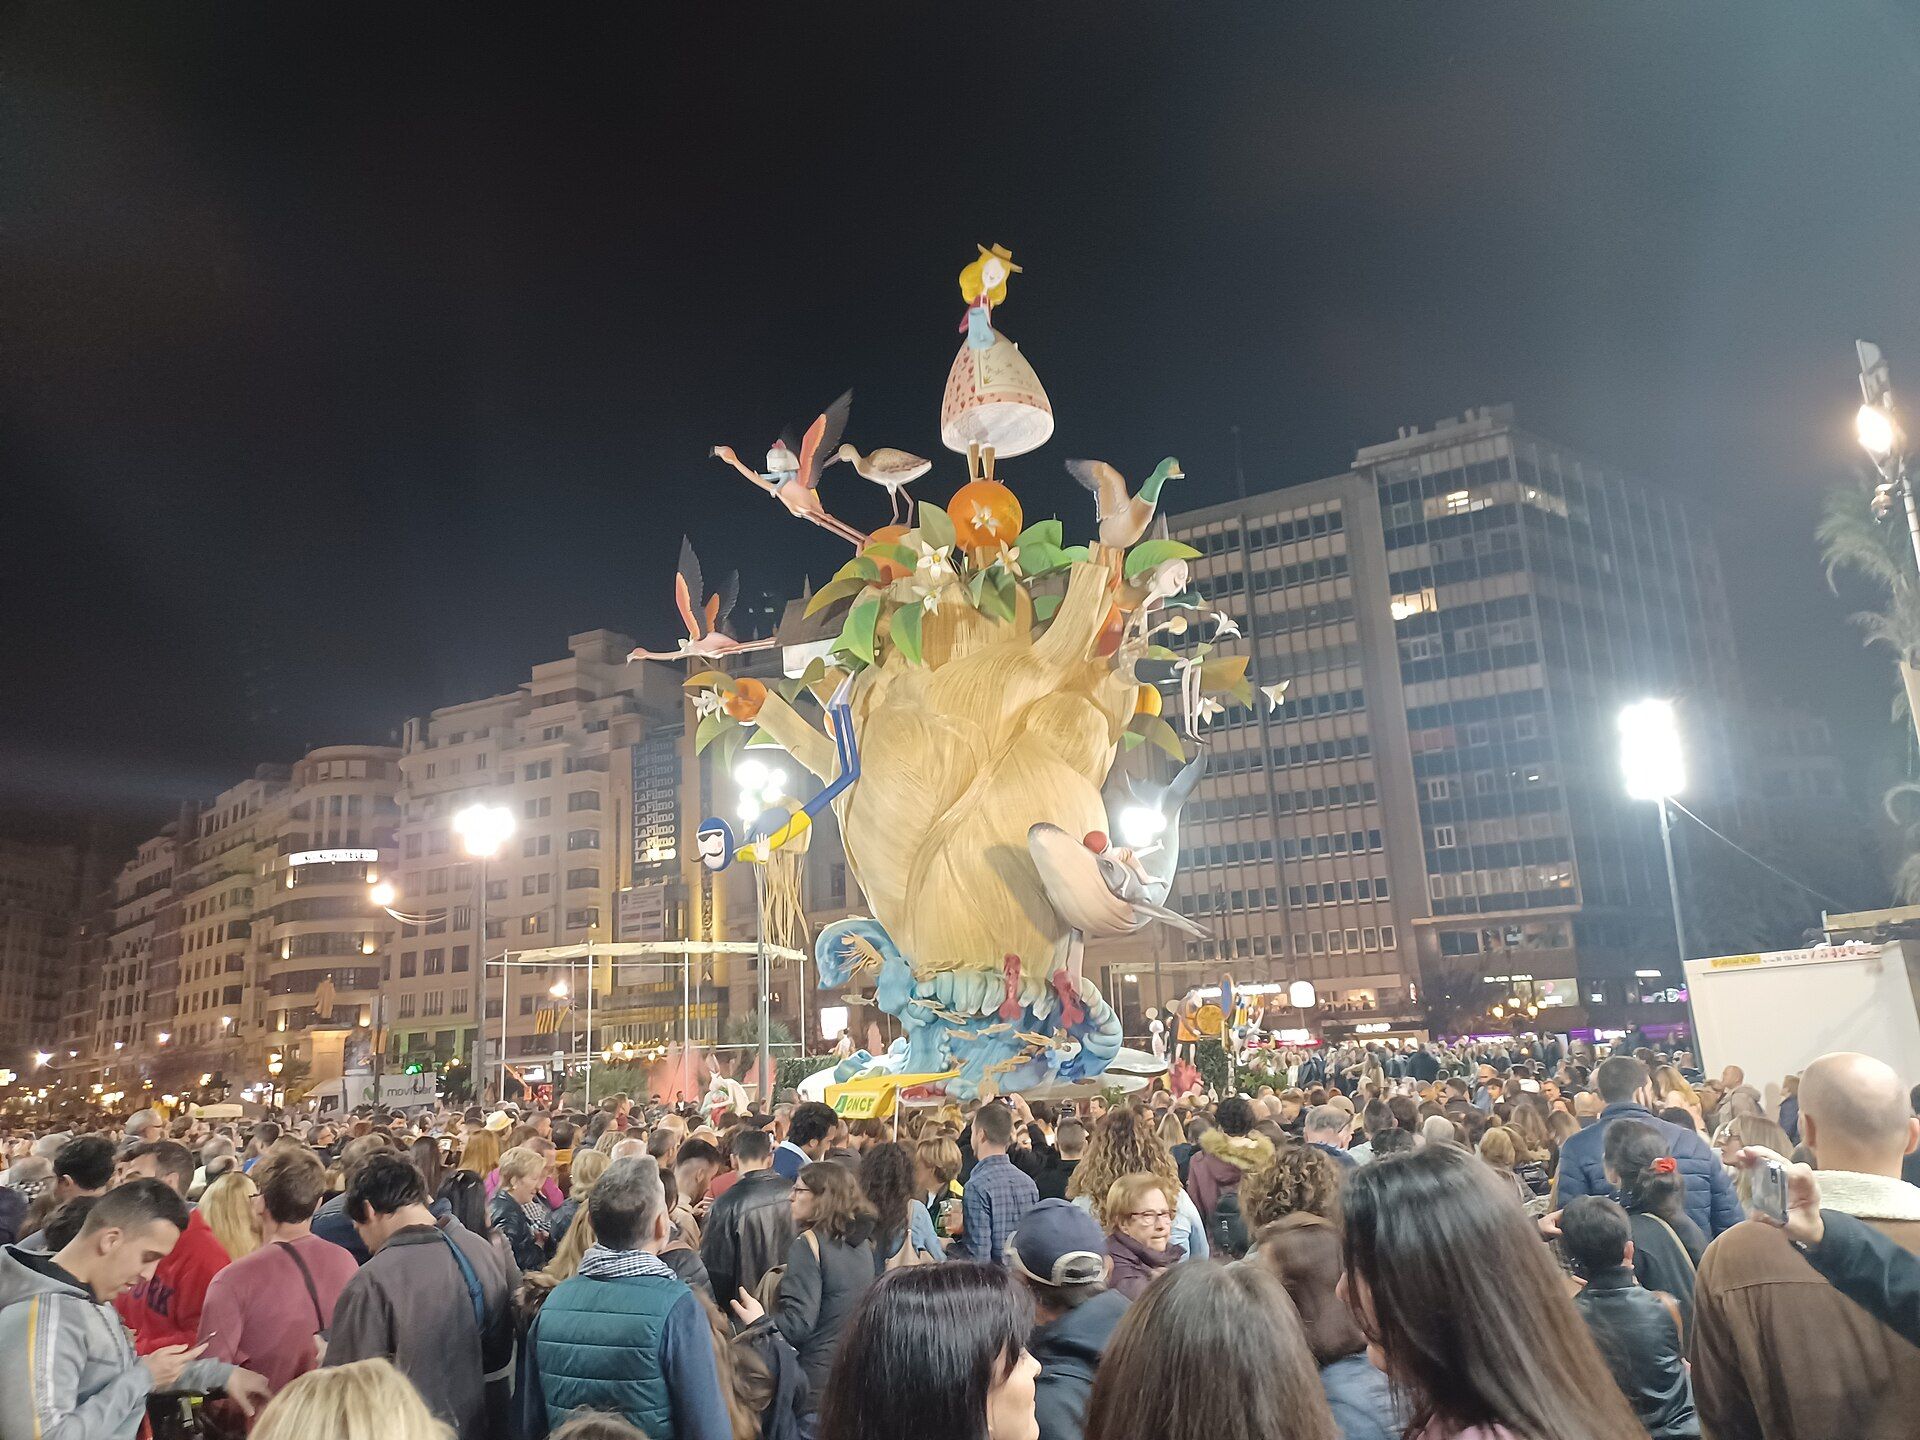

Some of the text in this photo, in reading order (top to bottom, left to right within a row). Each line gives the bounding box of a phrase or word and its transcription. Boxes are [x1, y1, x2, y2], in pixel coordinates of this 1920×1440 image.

[634, 789, 673, 802] LaFilmo
[634, 800, 674, 814] LaFilmo
[634, 812, 674, 826] LaFilmo
[634, 824, 675, 838] LaFilmo
